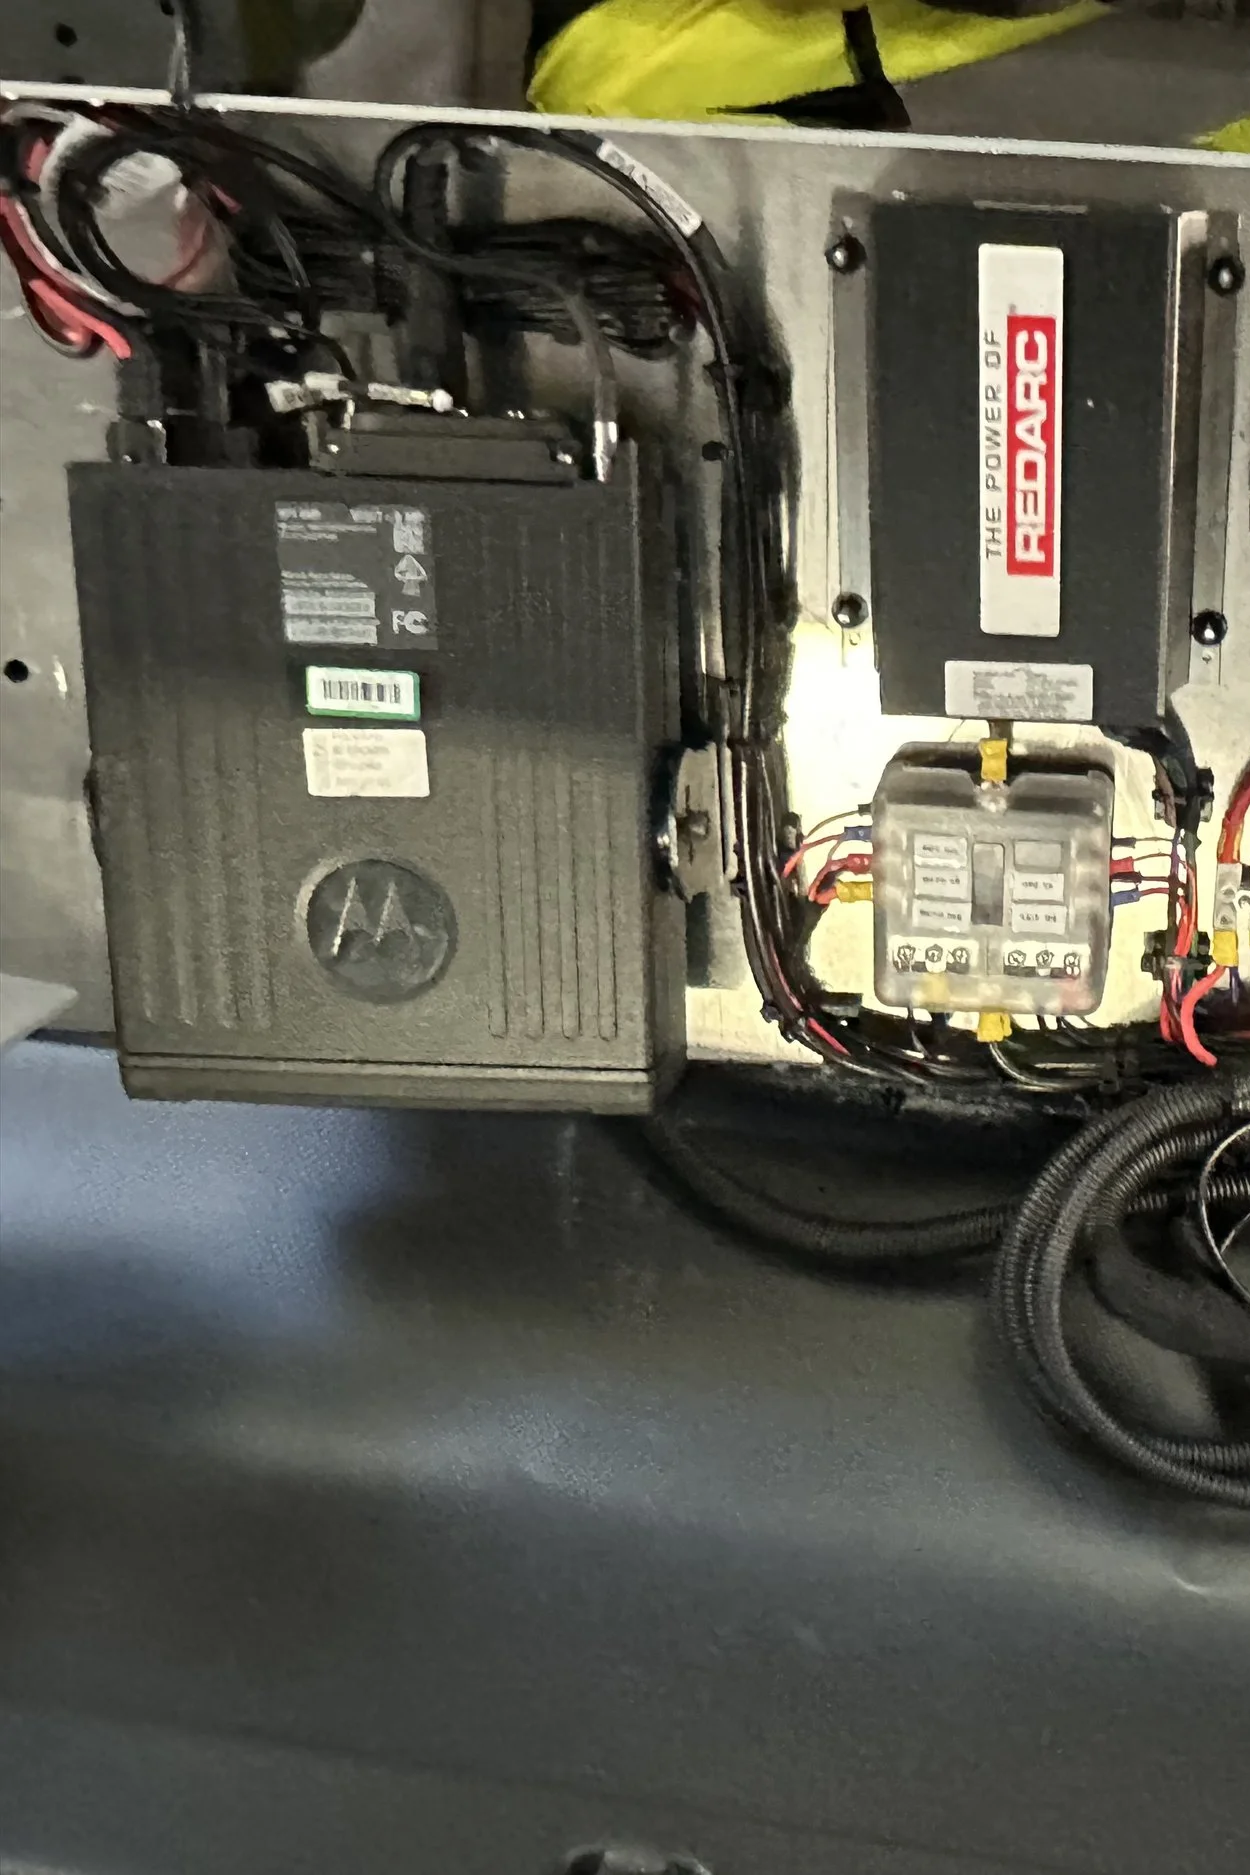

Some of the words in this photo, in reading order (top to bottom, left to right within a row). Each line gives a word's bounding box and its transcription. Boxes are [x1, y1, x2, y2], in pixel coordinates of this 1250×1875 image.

[984, 329, 1002, 371] OF
[984, 383, 1002, 492] POWER
[1014, 329, 1048, 563] REDARC
[984, 505, 1002, 560] THE
